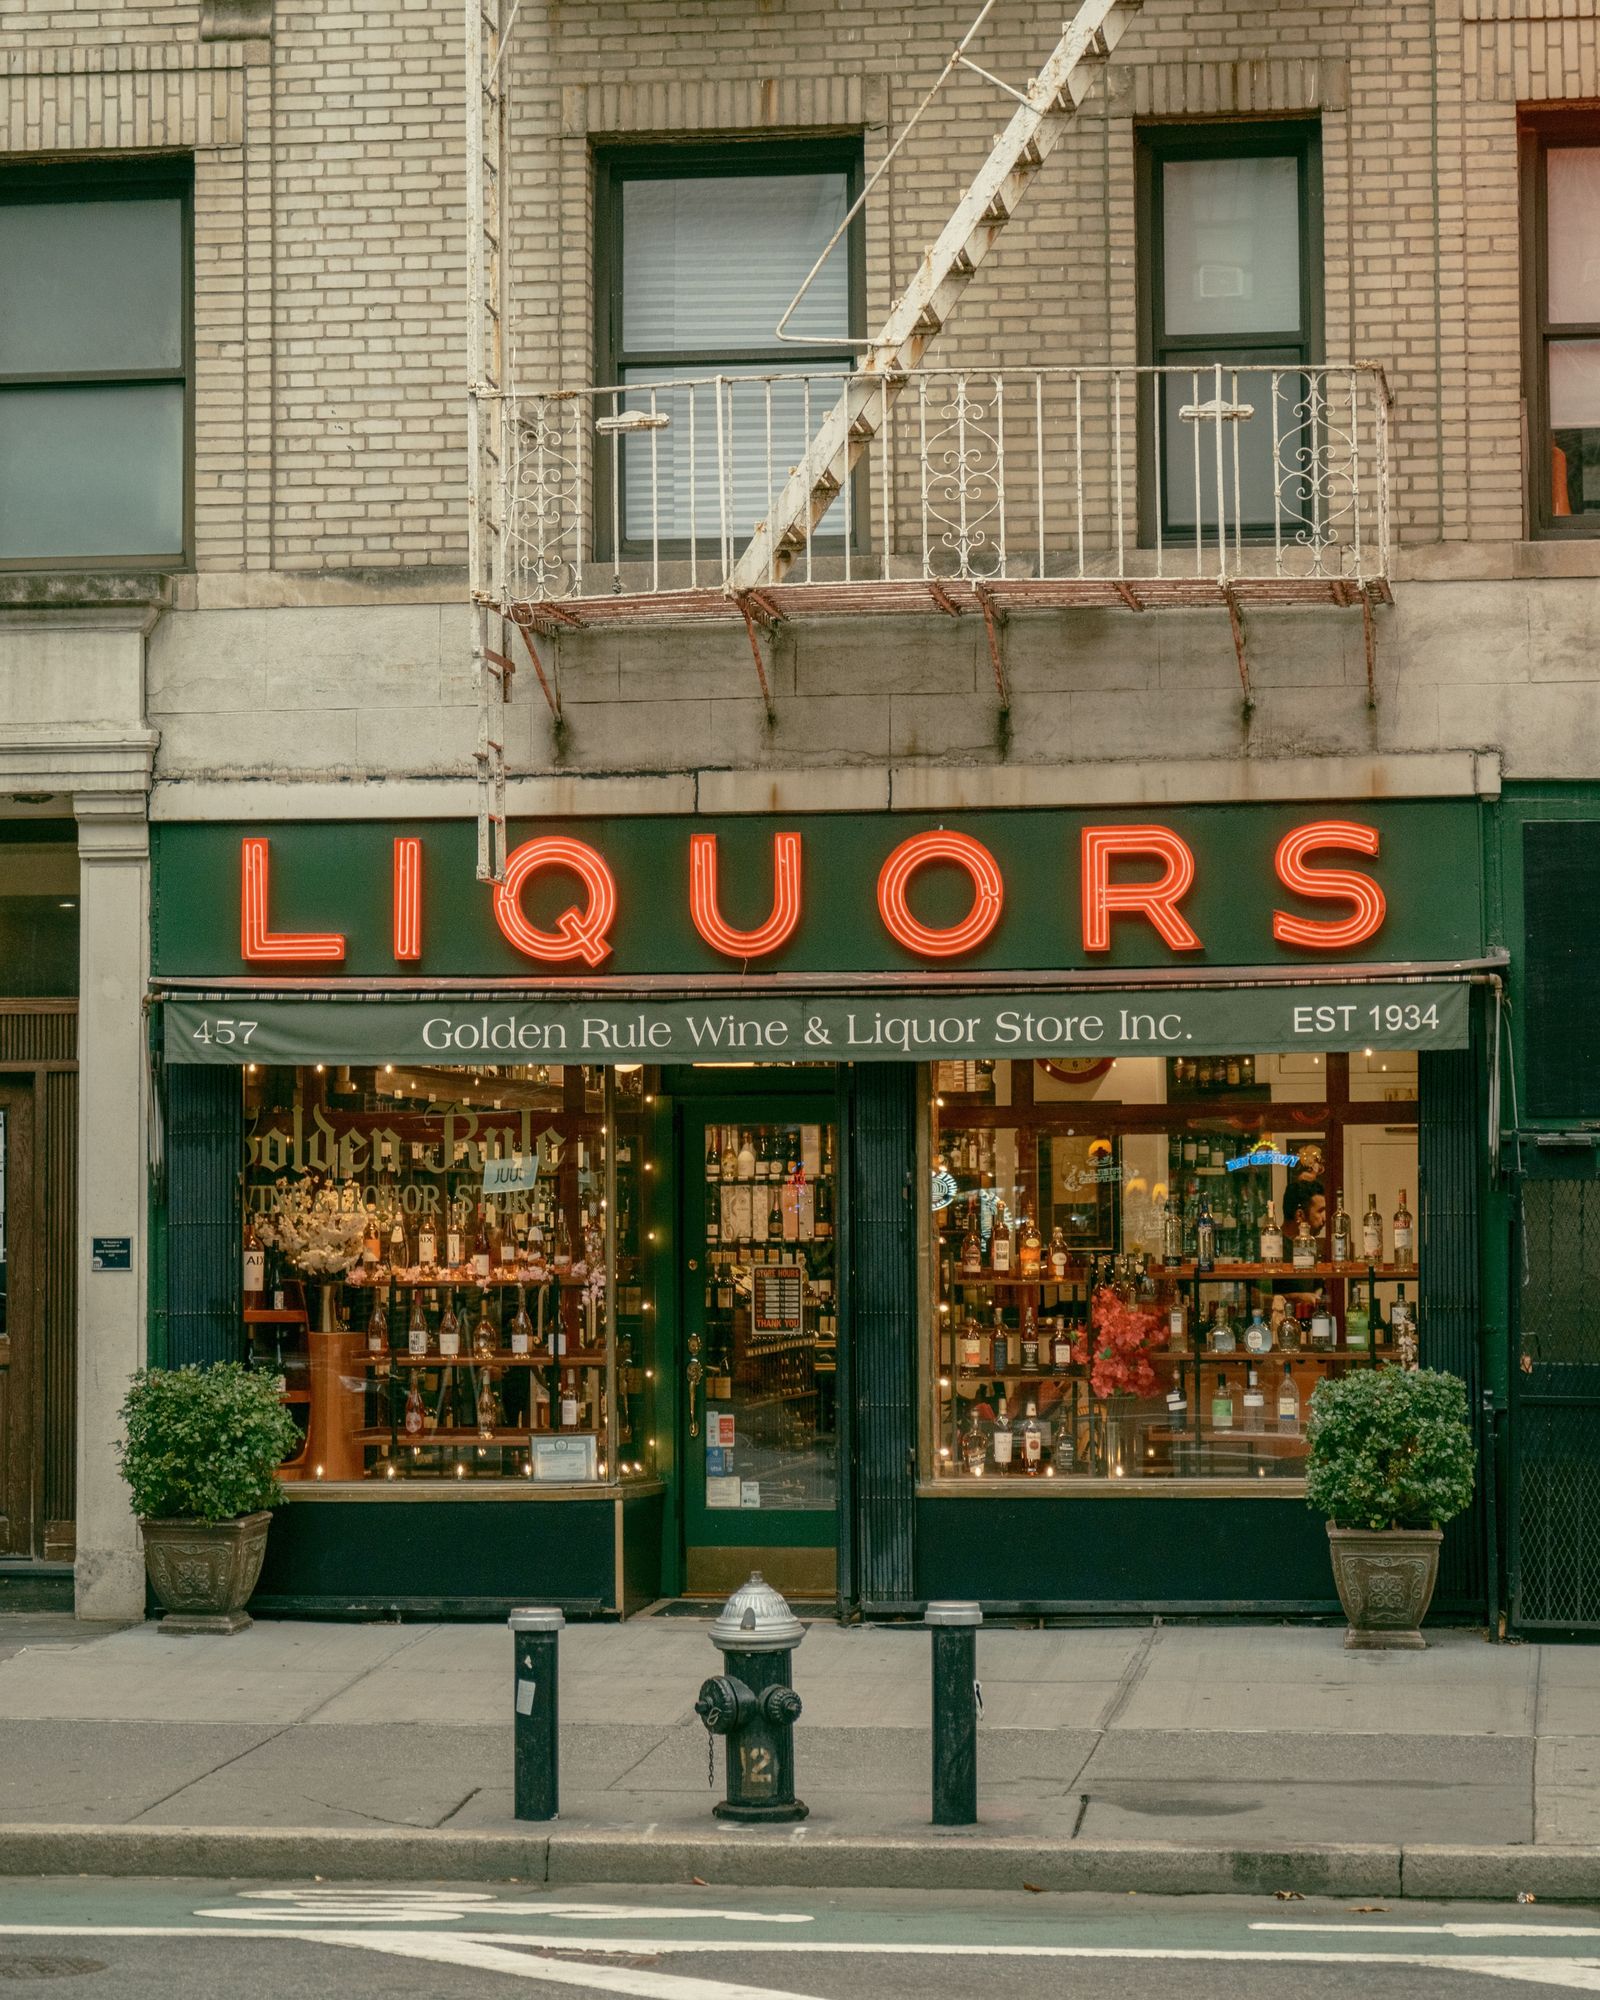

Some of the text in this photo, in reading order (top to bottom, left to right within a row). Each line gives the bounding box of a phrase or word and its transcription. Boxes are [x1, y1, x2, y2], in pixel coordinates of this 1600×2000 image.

[241, 820, 1387, 968] LIQUORS
[193, 1020, 258, 1044] 457
[422, 1010, 1193, 1051] Golden Rule Wine & Liquor Store Inc.
[1293, 1003, 1440, 1033] EST 1934
[424, 1099, 568, 1174] Rule
[336, 1184, 443, 1214] LIQUOR
[456, 1184, 551, 1214] STORE
[755, 1269, 800, 1278] STORE HOURS
[756, 1319, 799, 1328] THANK YOU
